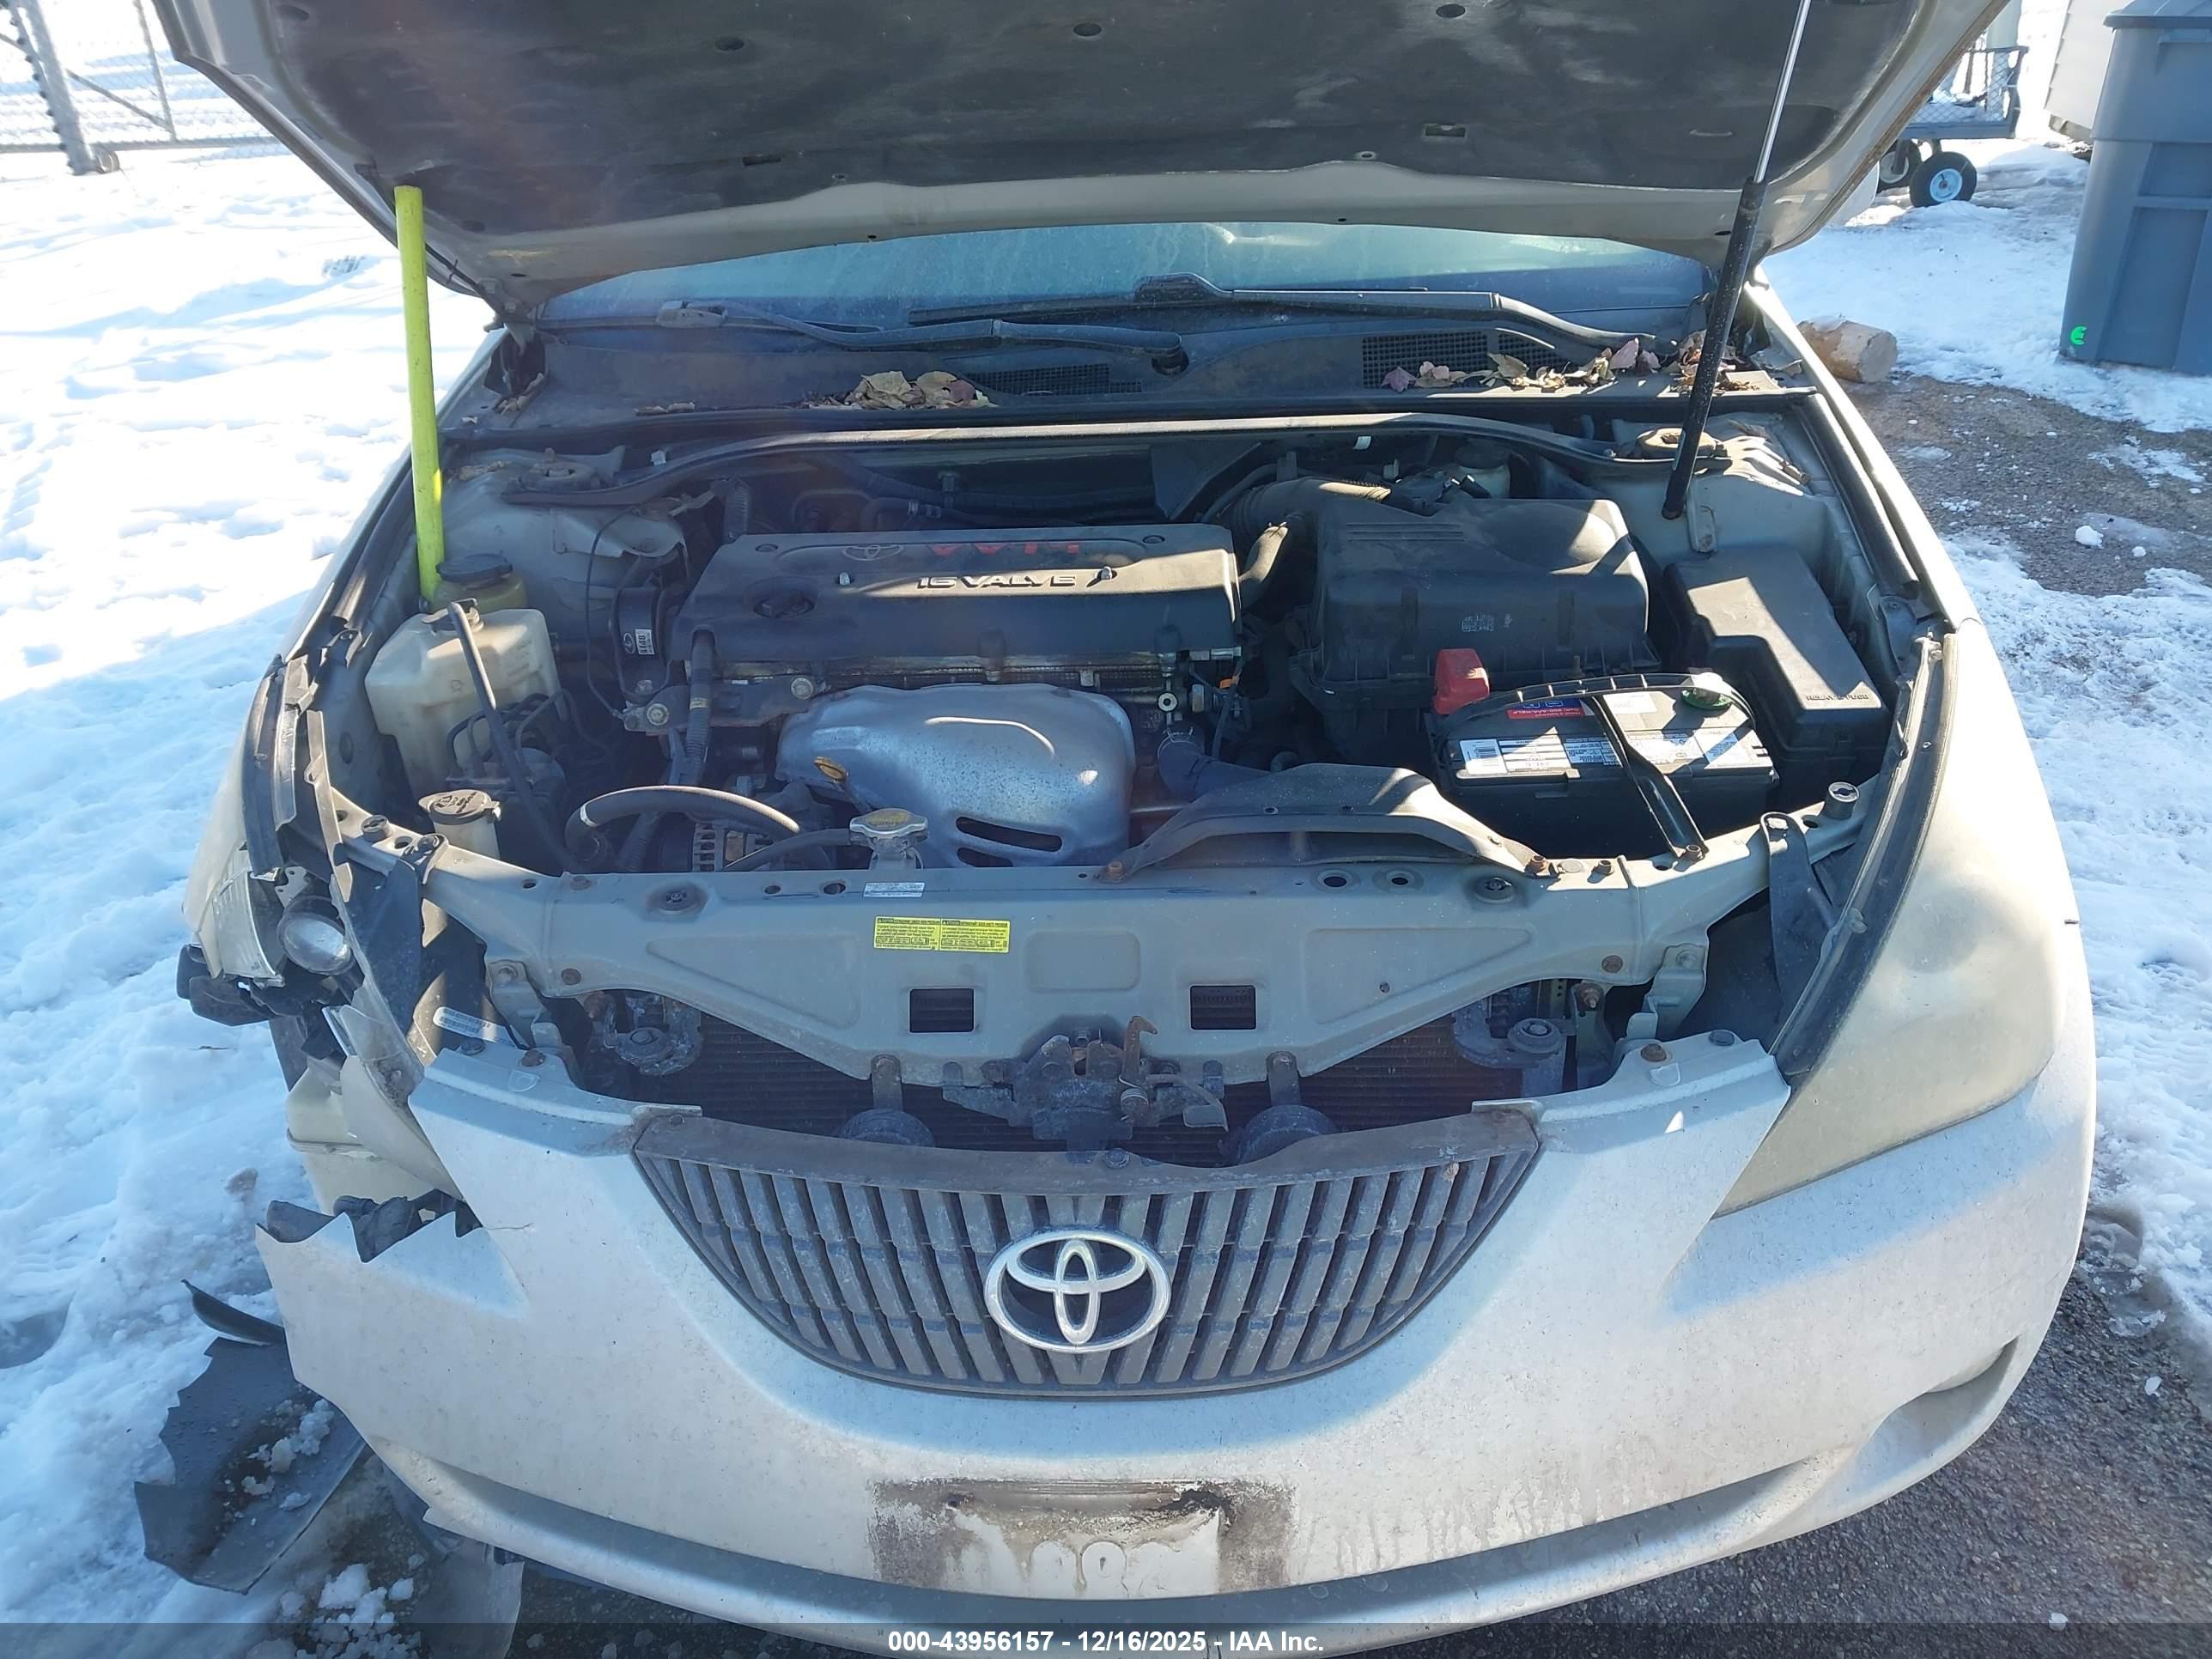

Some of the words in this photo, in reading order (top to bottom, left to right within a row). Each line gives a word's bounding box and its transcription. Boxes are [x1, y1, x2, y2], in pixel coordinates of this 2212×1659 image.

[917, 576, 957, 589] 16
[961, 575, 1076, 588] VALVE
[1806, 693, 1834, 702] RELAY
